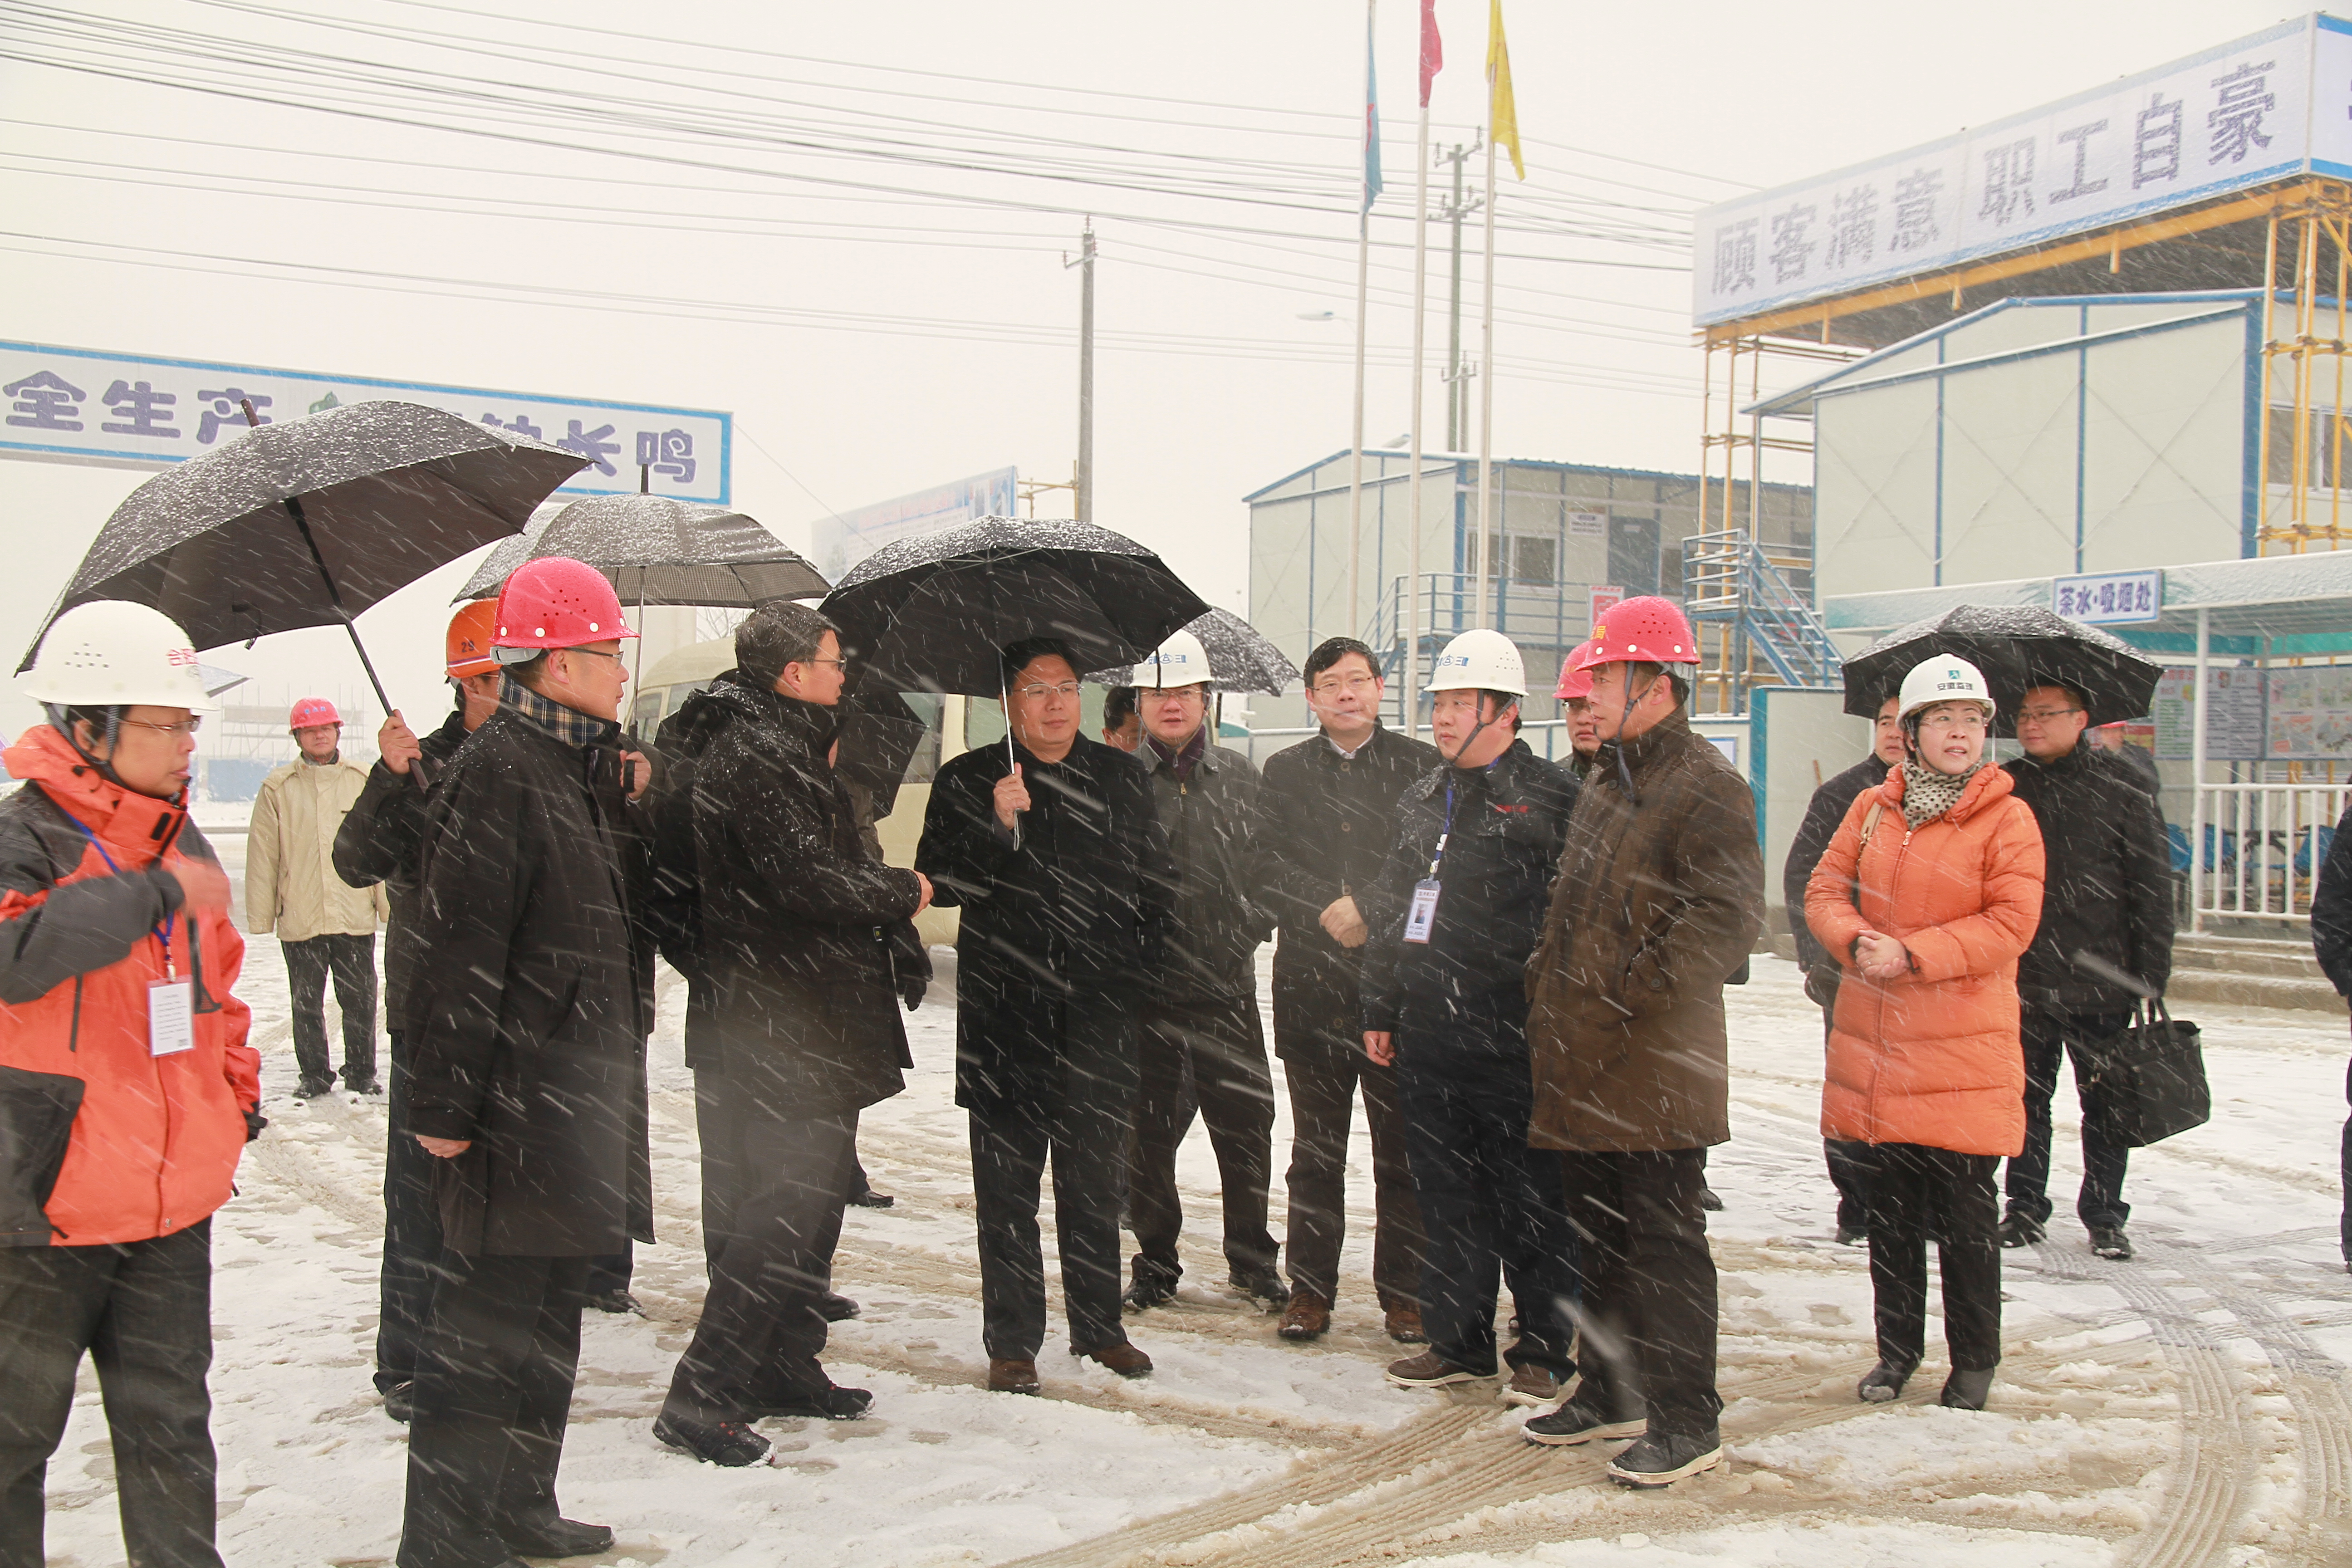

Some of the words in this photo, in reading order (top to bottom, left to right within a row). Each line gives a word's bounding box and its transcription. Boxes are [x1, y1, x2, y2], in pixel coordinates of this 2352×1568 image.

[1711, 167, 1944, 296] 顾客满意
[1978, 59, 2276, 227] 职工自豪
[2, 370, 273, 444] 全生产
